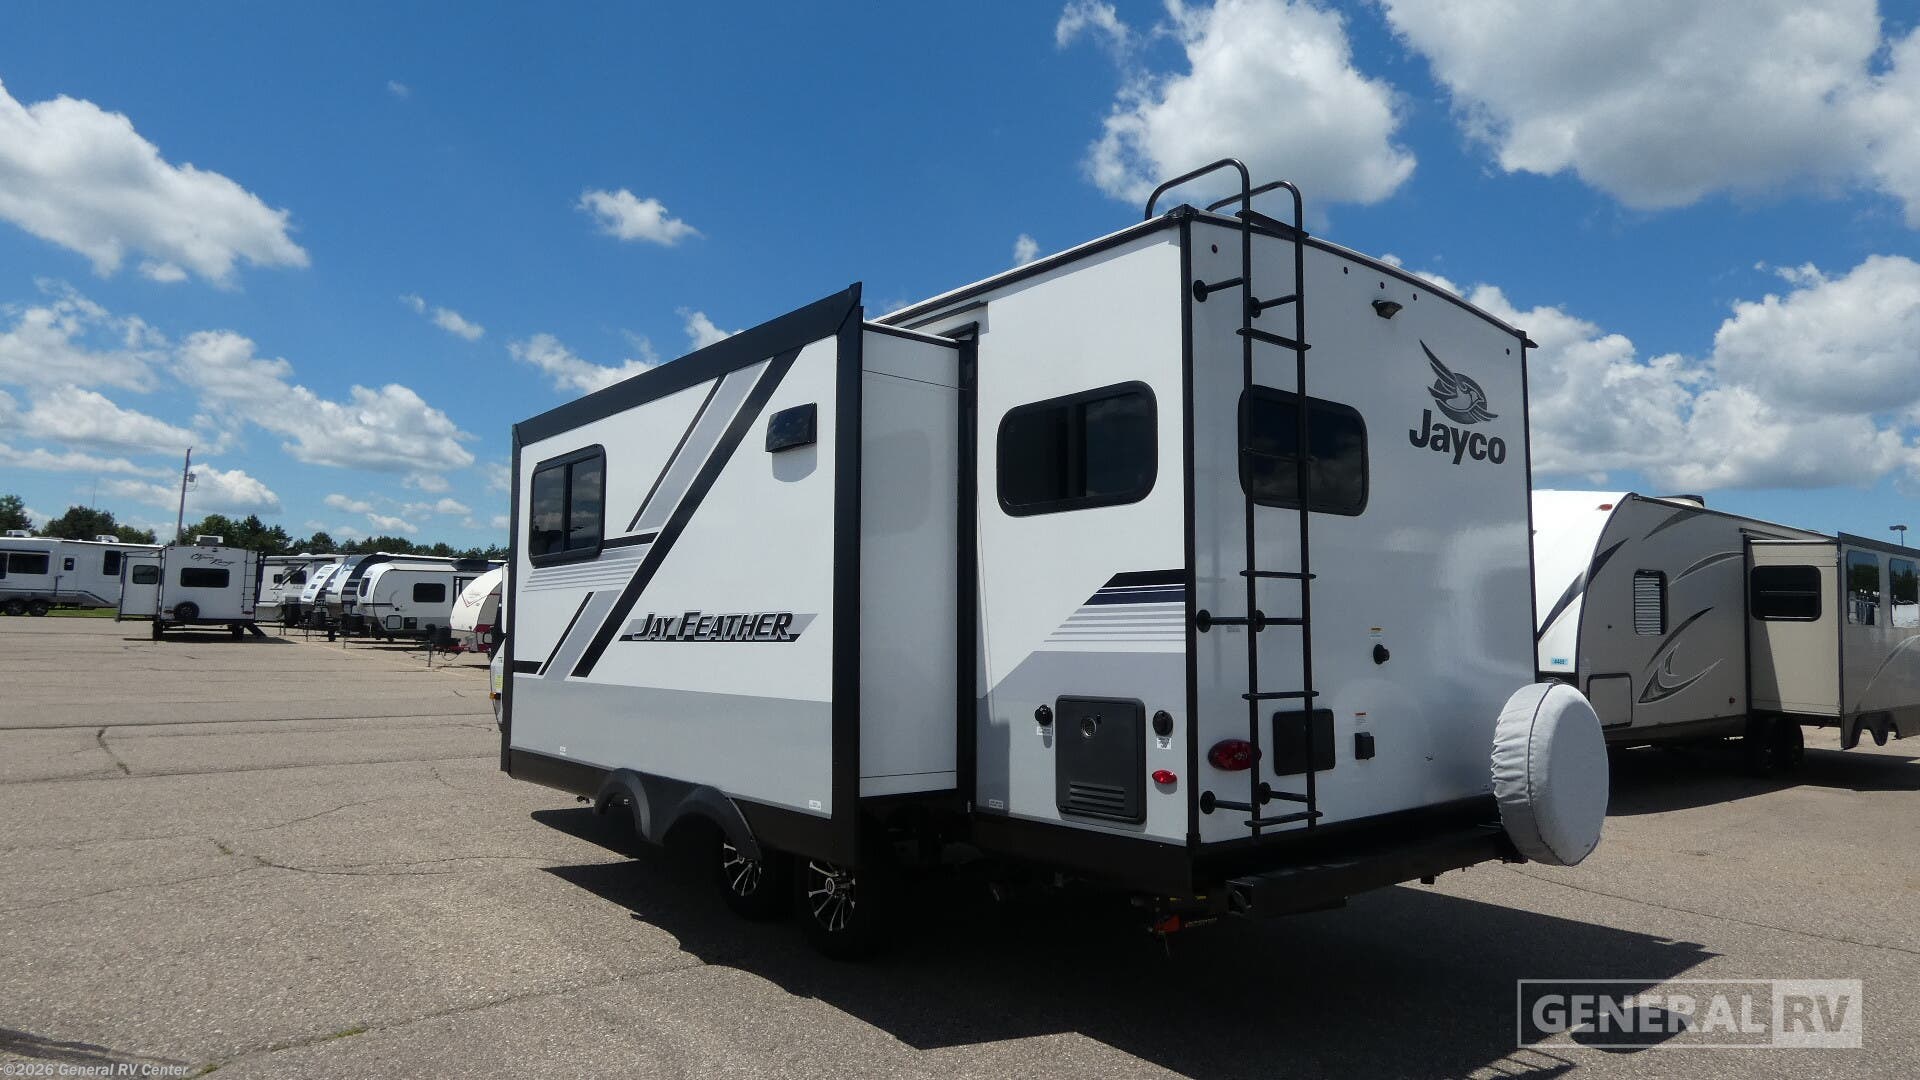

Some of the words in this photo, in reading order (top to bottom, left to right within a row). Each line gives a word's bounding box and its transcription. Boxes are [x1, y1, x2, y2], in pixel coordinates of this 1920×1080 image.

[1409, 409, 1506, 465] Jayco
[632, 612, 675, 640] JAY
[676, 610, 794, 640] FEATHER
